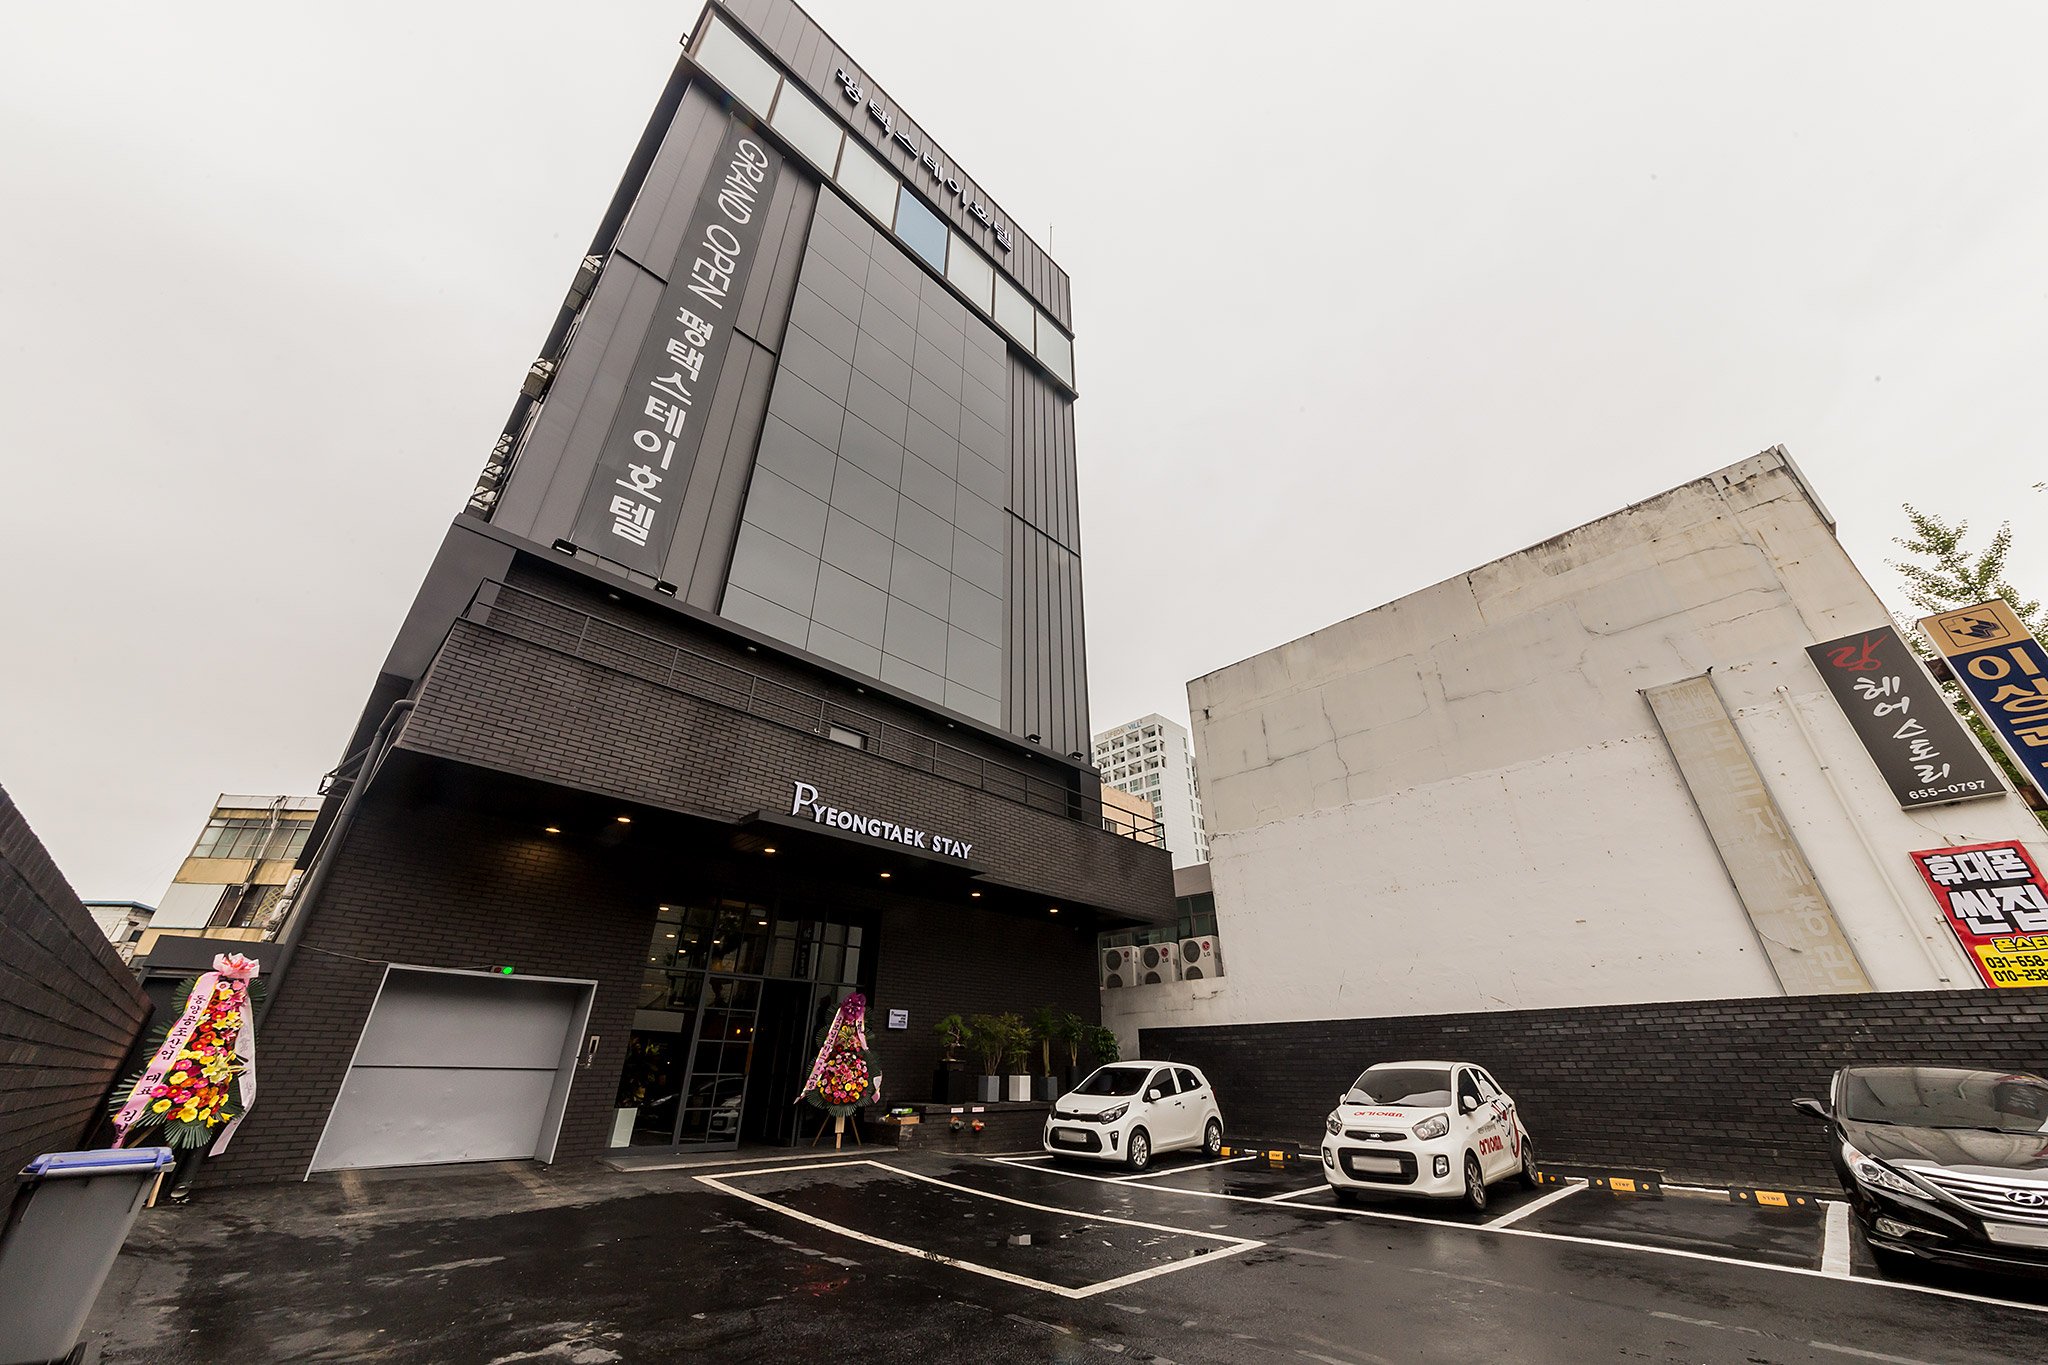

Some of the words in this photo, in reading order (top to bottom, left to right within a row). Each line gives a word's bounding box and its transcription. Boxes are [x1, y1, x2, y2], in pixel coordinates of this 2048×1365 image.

[716, 137, 769, 226] GRAND
[835, 67, 1012, 253] 평택스테이호텔
[686, 223, 741, 309] OPEN
[608, 306, 714, 548] 평택스테이호텔
[792, 781, 926, 849] PYEONGTAEK
[932, 835, 973, 859] STAY
[1908, 780, 1986, 799] 655-0797
[1923, 848, 2032, 886] 휴대폰
[1949, 884, 2048, 935] 싼집
[1993, 968, 2048, 982] 010-258
